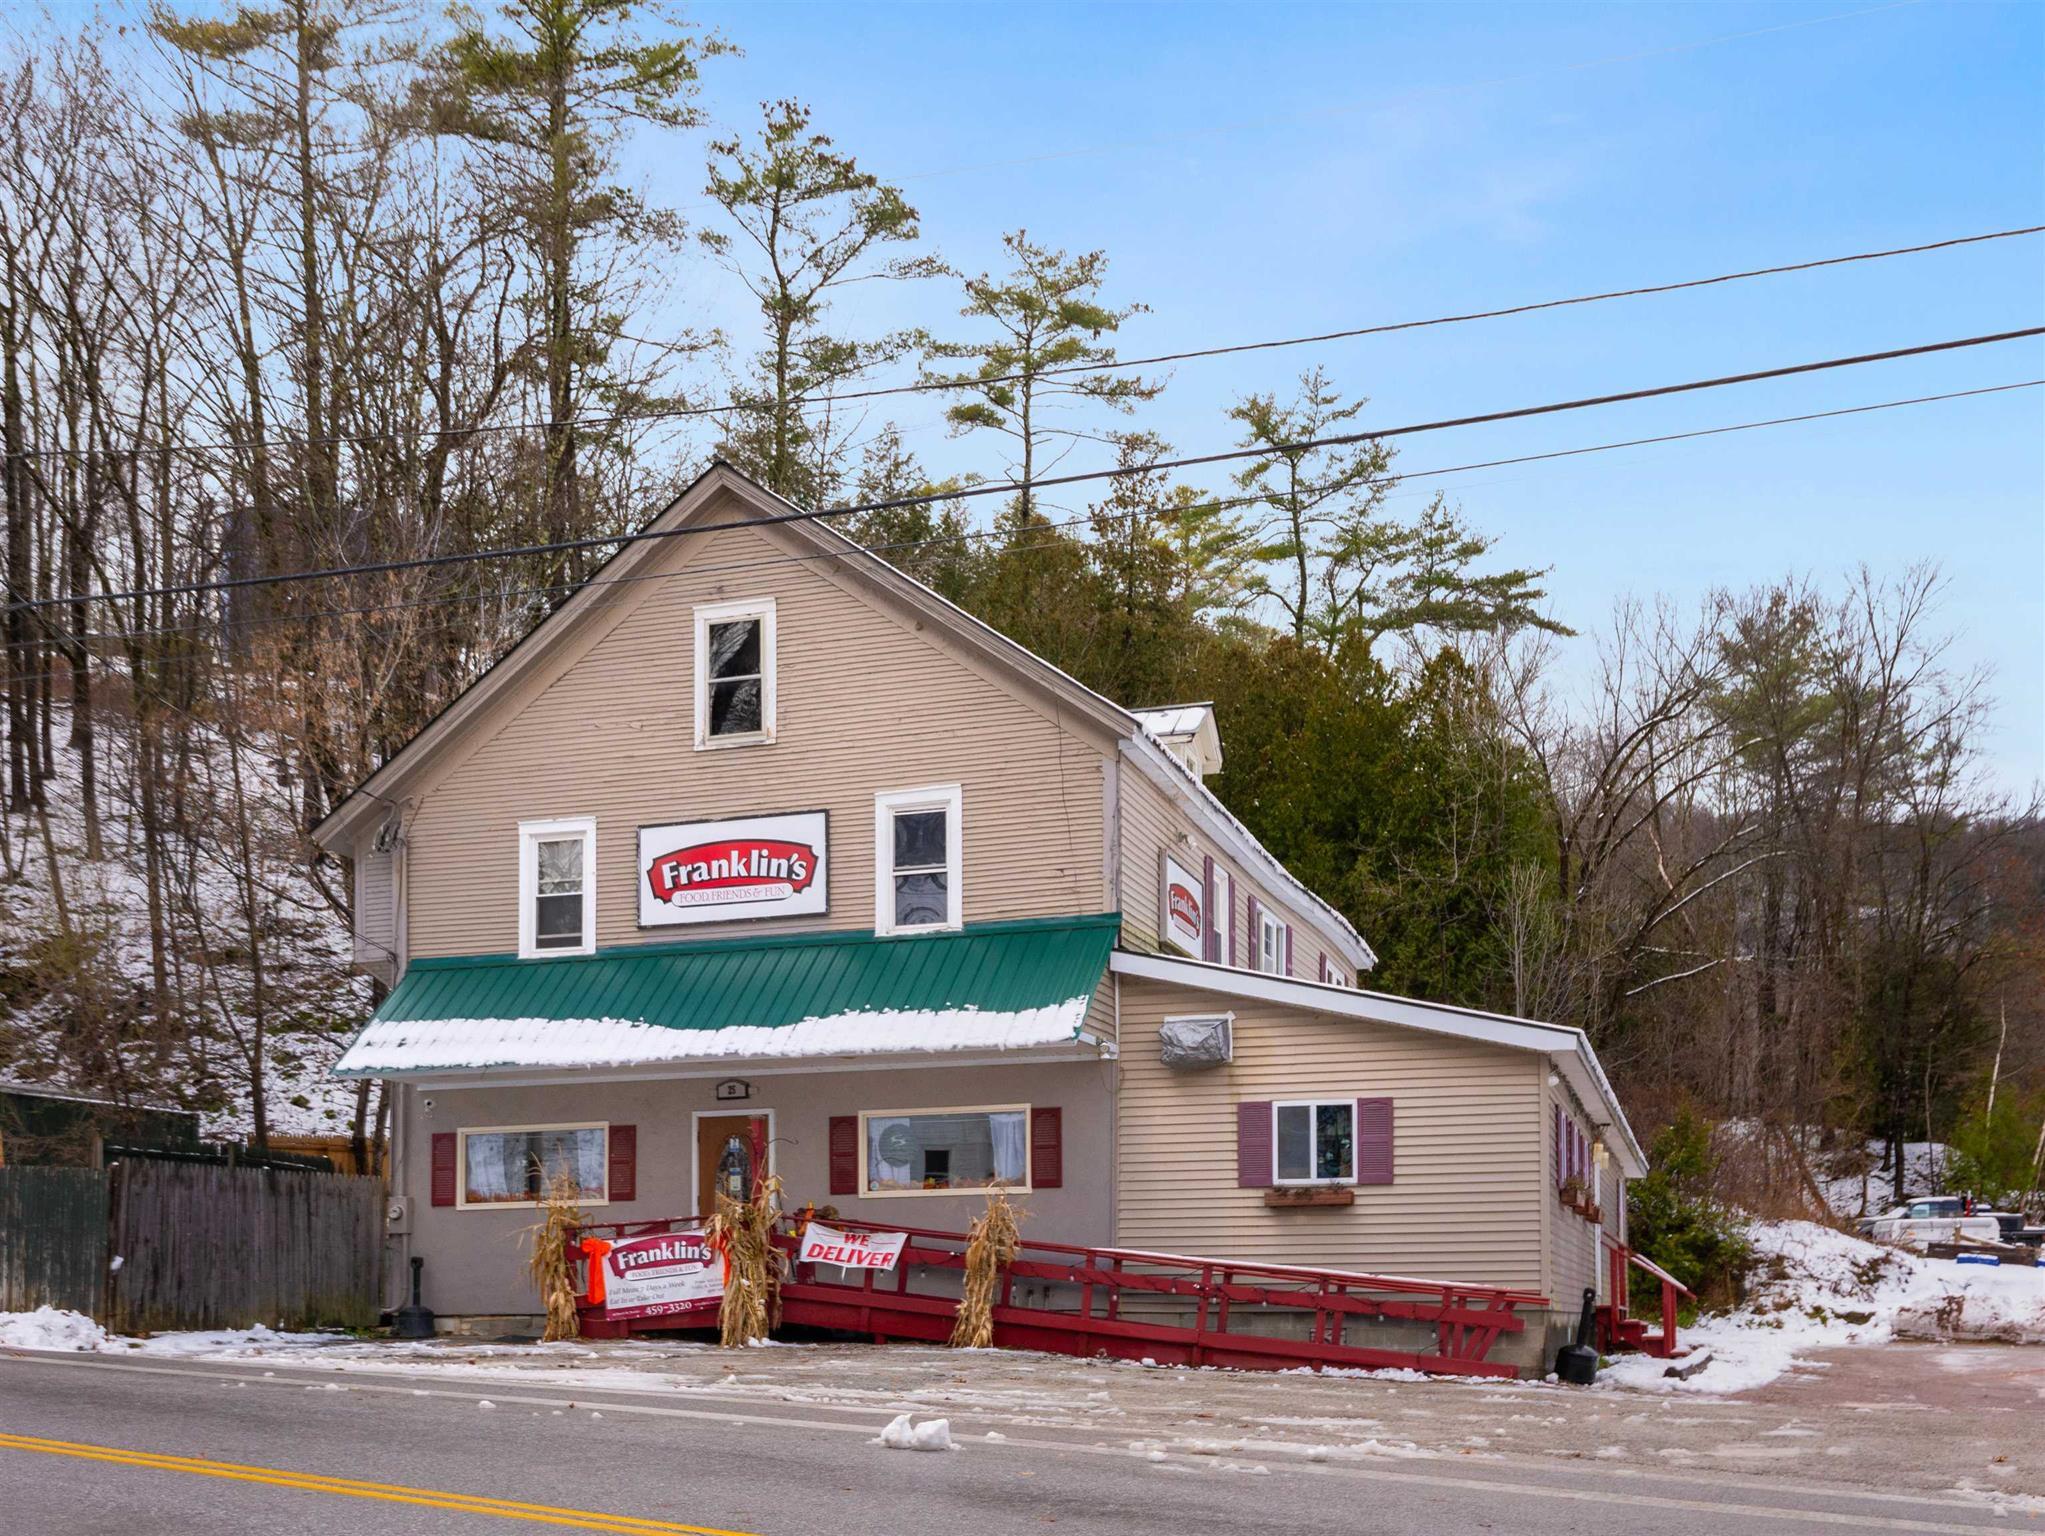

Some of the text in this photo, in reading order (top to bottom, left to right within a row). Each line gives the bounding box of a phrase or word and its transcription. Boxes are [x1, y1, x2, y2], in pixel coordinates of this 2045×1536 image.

[661, 848, 807, 890] Franklin's
[765, 886, 785, 897] FUN
[844, 1233, 871, 1246] WE
[617, 1241, 712, 1270] Franklin's
[807, 1243, 895, 1267] DELIVER
[645, 1301, 692, 1316] 459-3320
